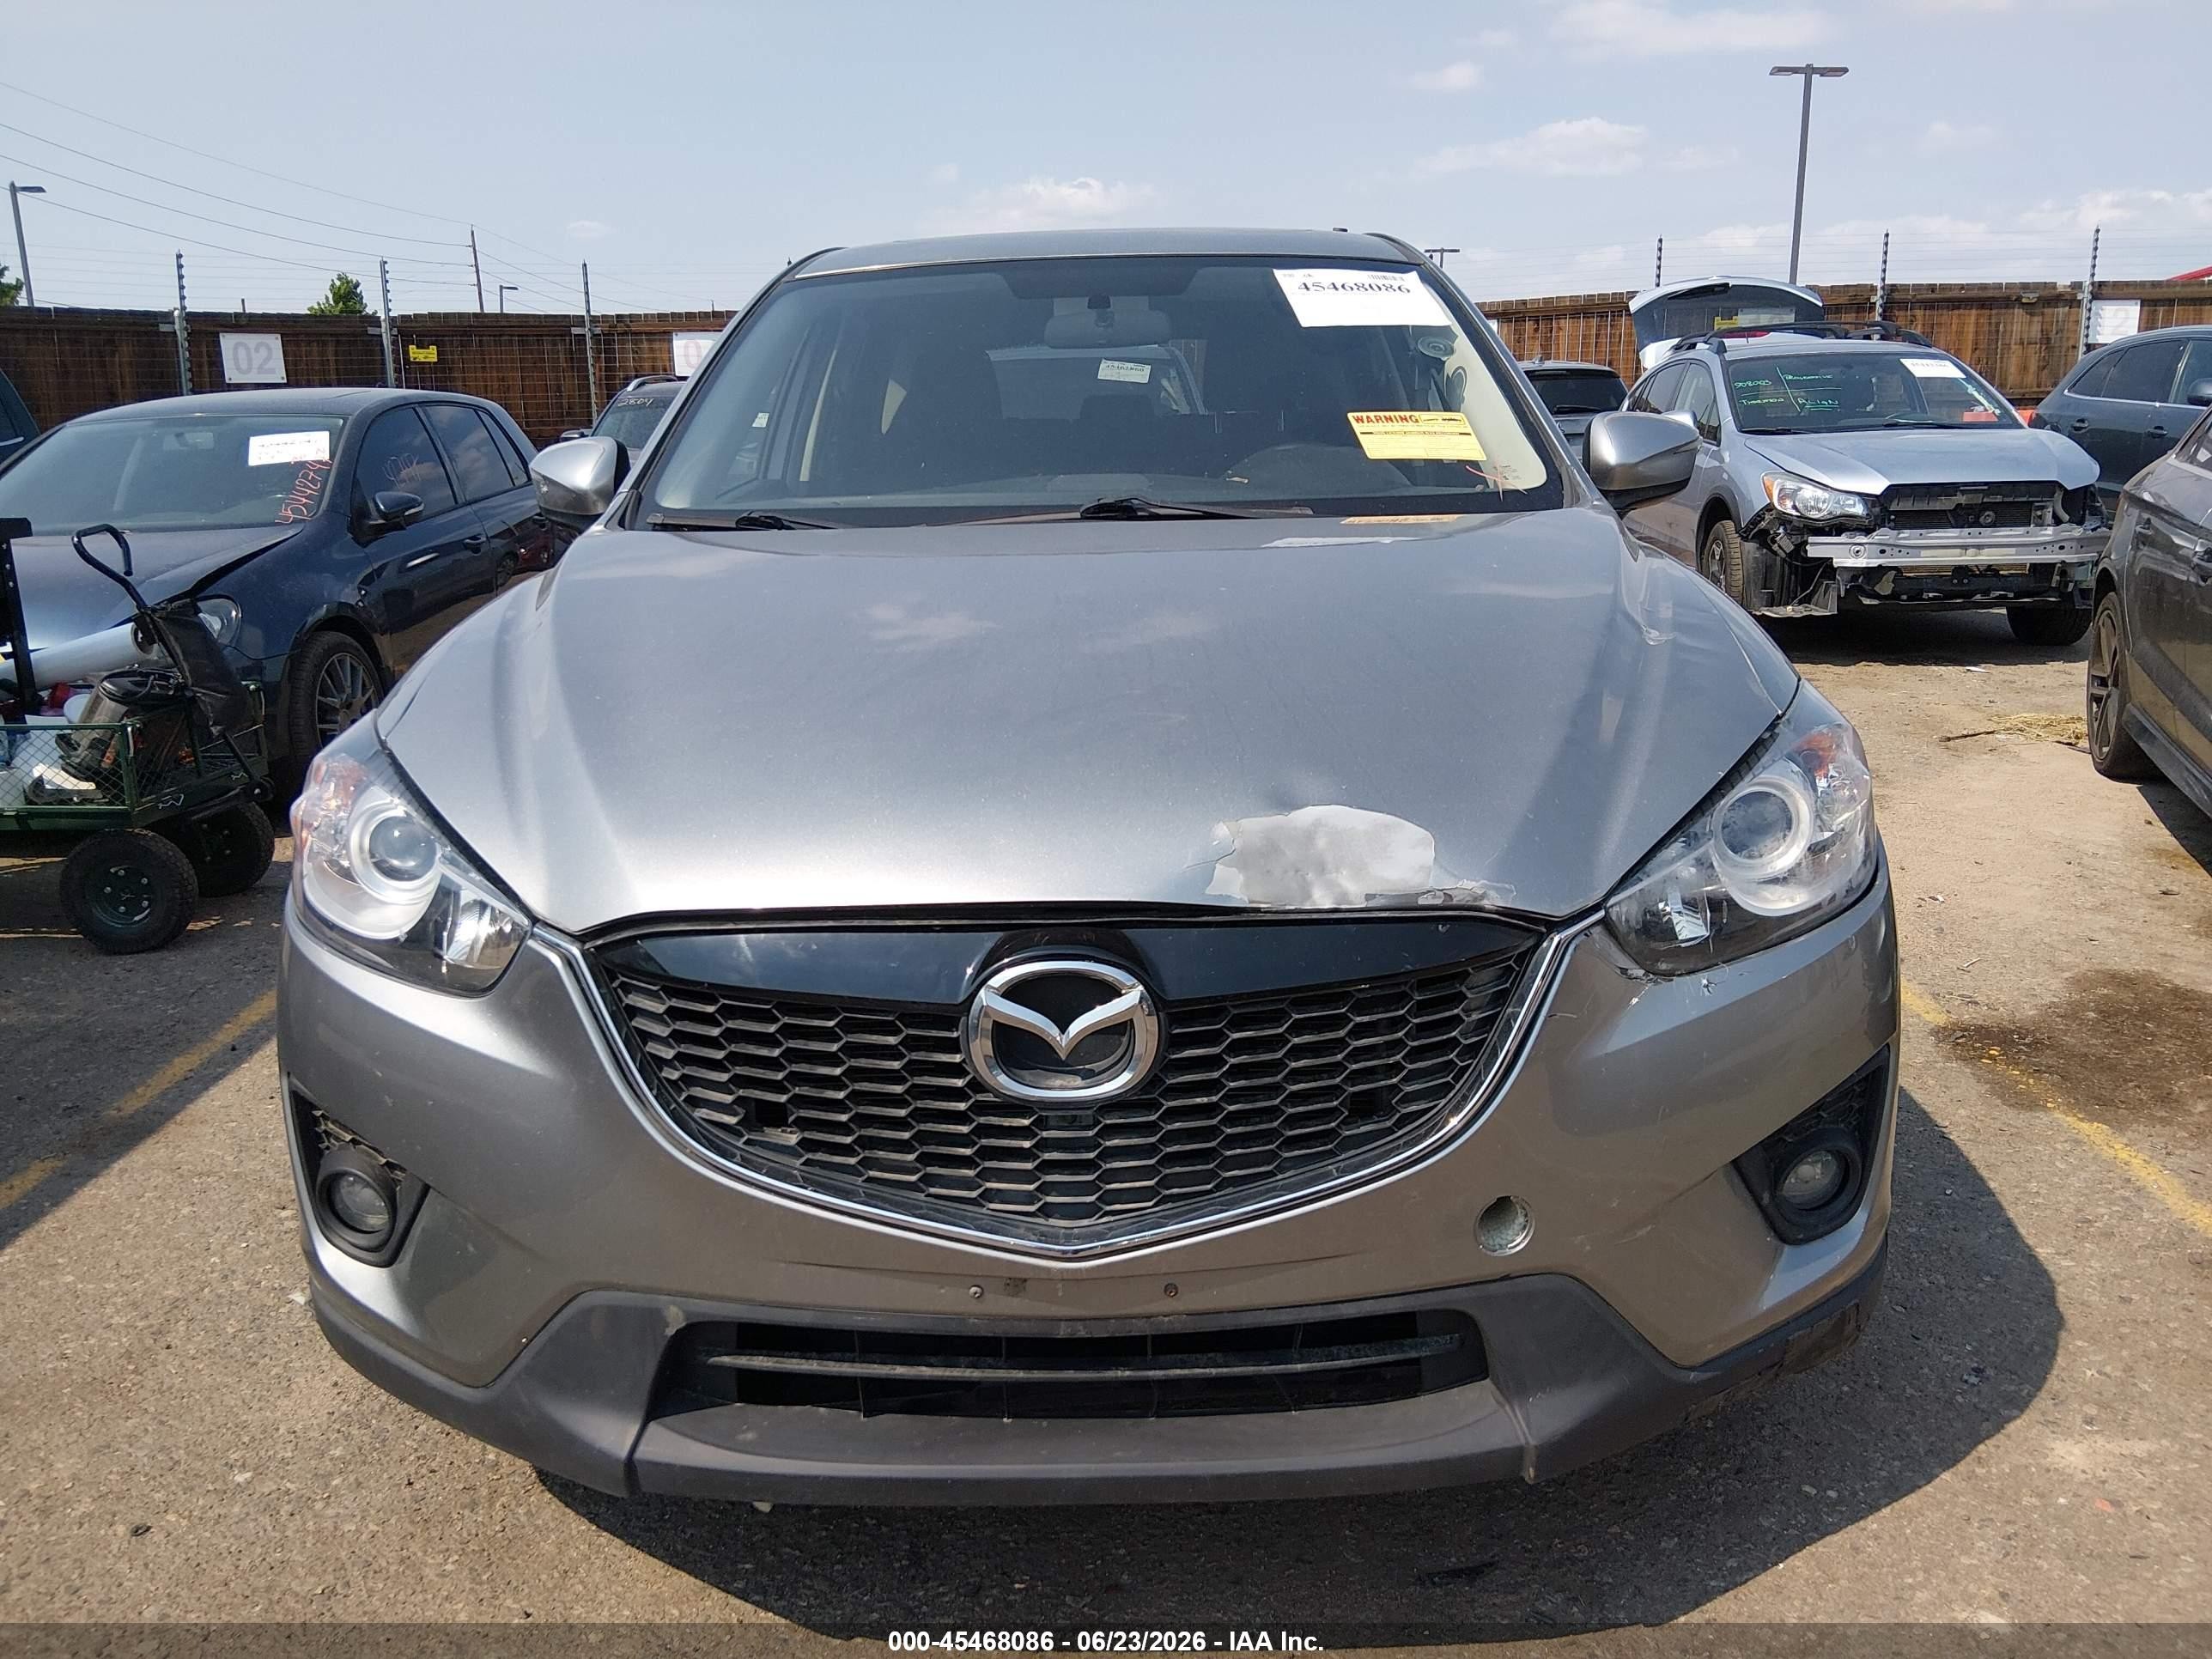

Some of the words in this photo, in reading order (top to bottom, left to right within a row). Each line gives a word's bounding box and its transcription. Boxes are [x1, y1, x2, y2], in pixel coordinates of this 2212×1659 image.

[1297, 282, 1412, 295] 45468086
[232, 341, 277, 375] 02
[1352, 415, 1420, 424] WARNING
